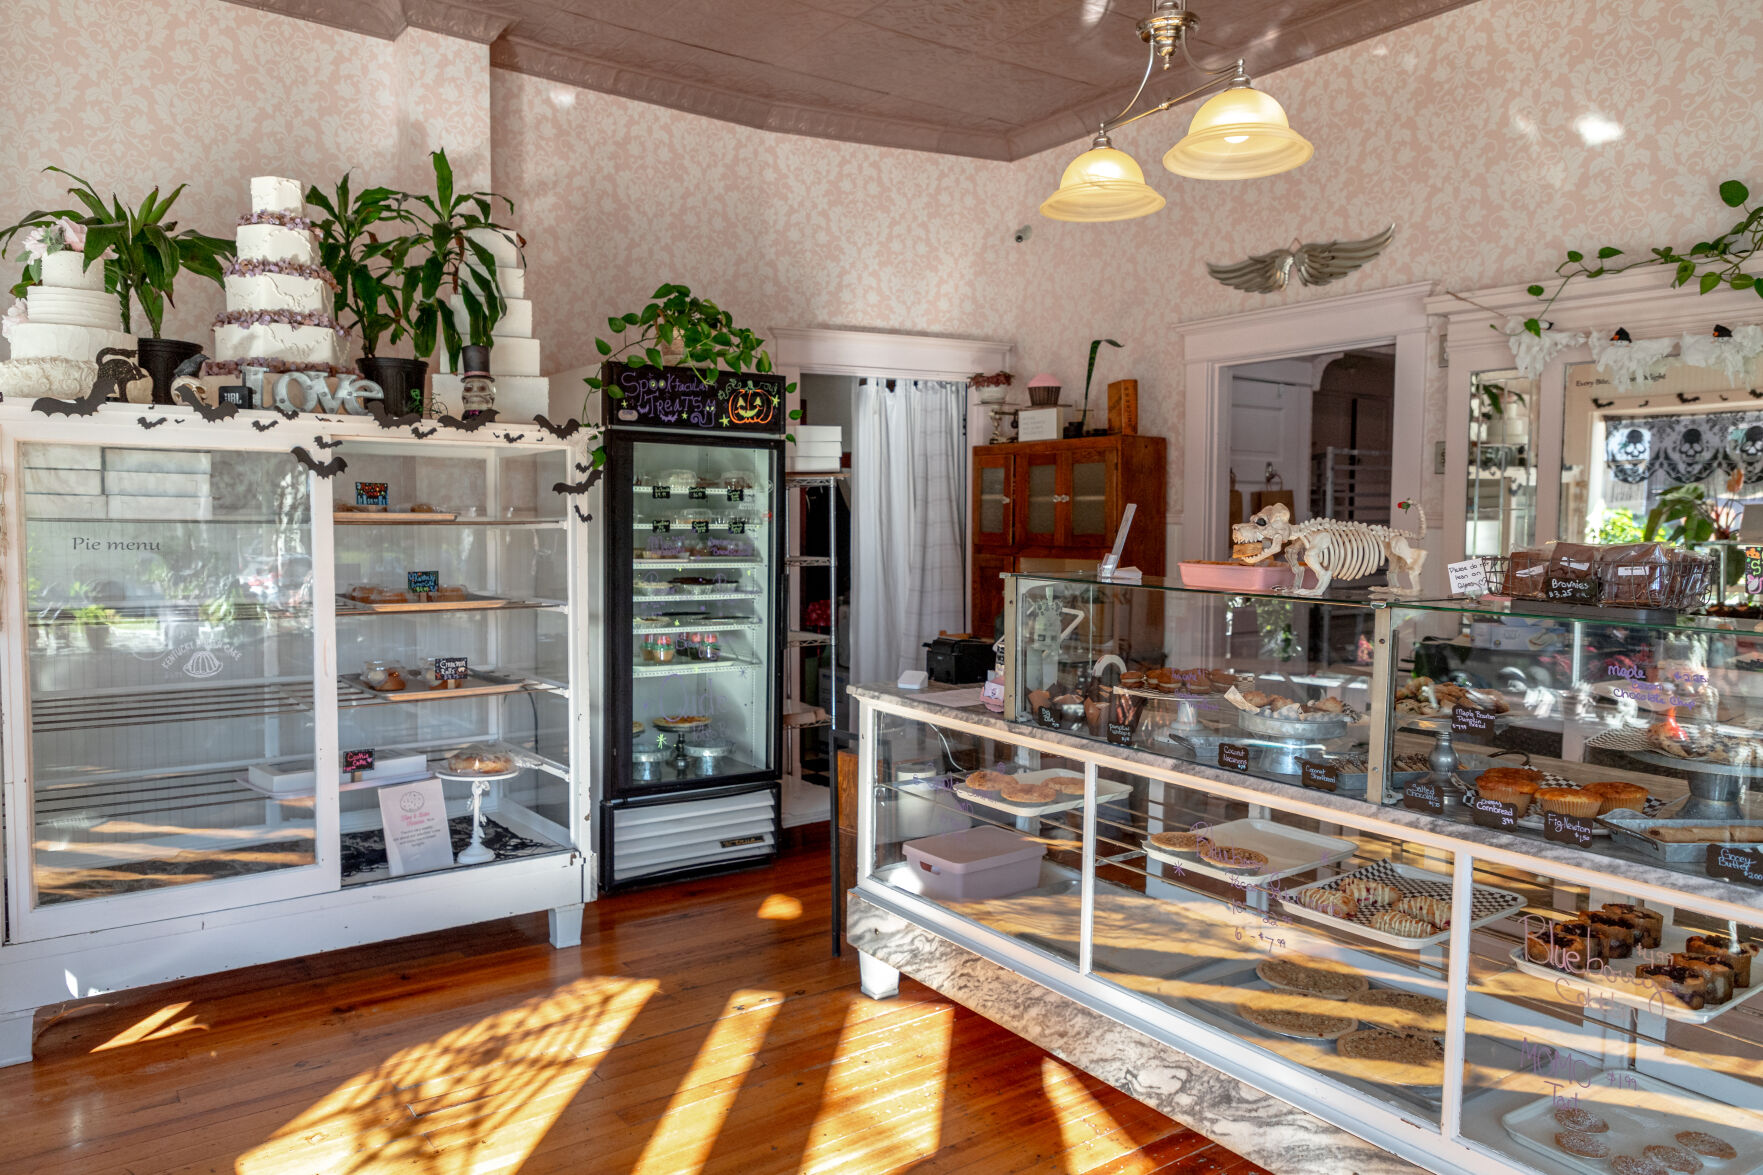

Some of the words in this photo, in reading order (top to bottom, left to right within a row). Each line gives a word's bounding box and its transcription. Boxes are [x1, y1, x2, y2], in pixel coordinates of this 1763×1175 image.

[224, 392, 242, 404] JBL
[72, 537, 101, 550] Pie
[106, 541, 161, 550] menu
[1449, 563, 1468, 573] Please
[1551, 579, 1589, 590] Brownies
[161, 641, 194, 669] KENTUCKY
[1607, 665, 1646, 682] Maple
[1613, 688, 1667, 704] Chocolate
[1455, 708, 1474, 718] Maple
[1412, 783, 1435, 795] Salted
[1476, 801, 1514, 817] Cornbread
[1548, 813, 1562, 832] Fig
[1563, 816, 1591, 834] Newton
[1720, 847, 1757, 867] Gooey
[1543, 1080, 1578, 1114] Tart
